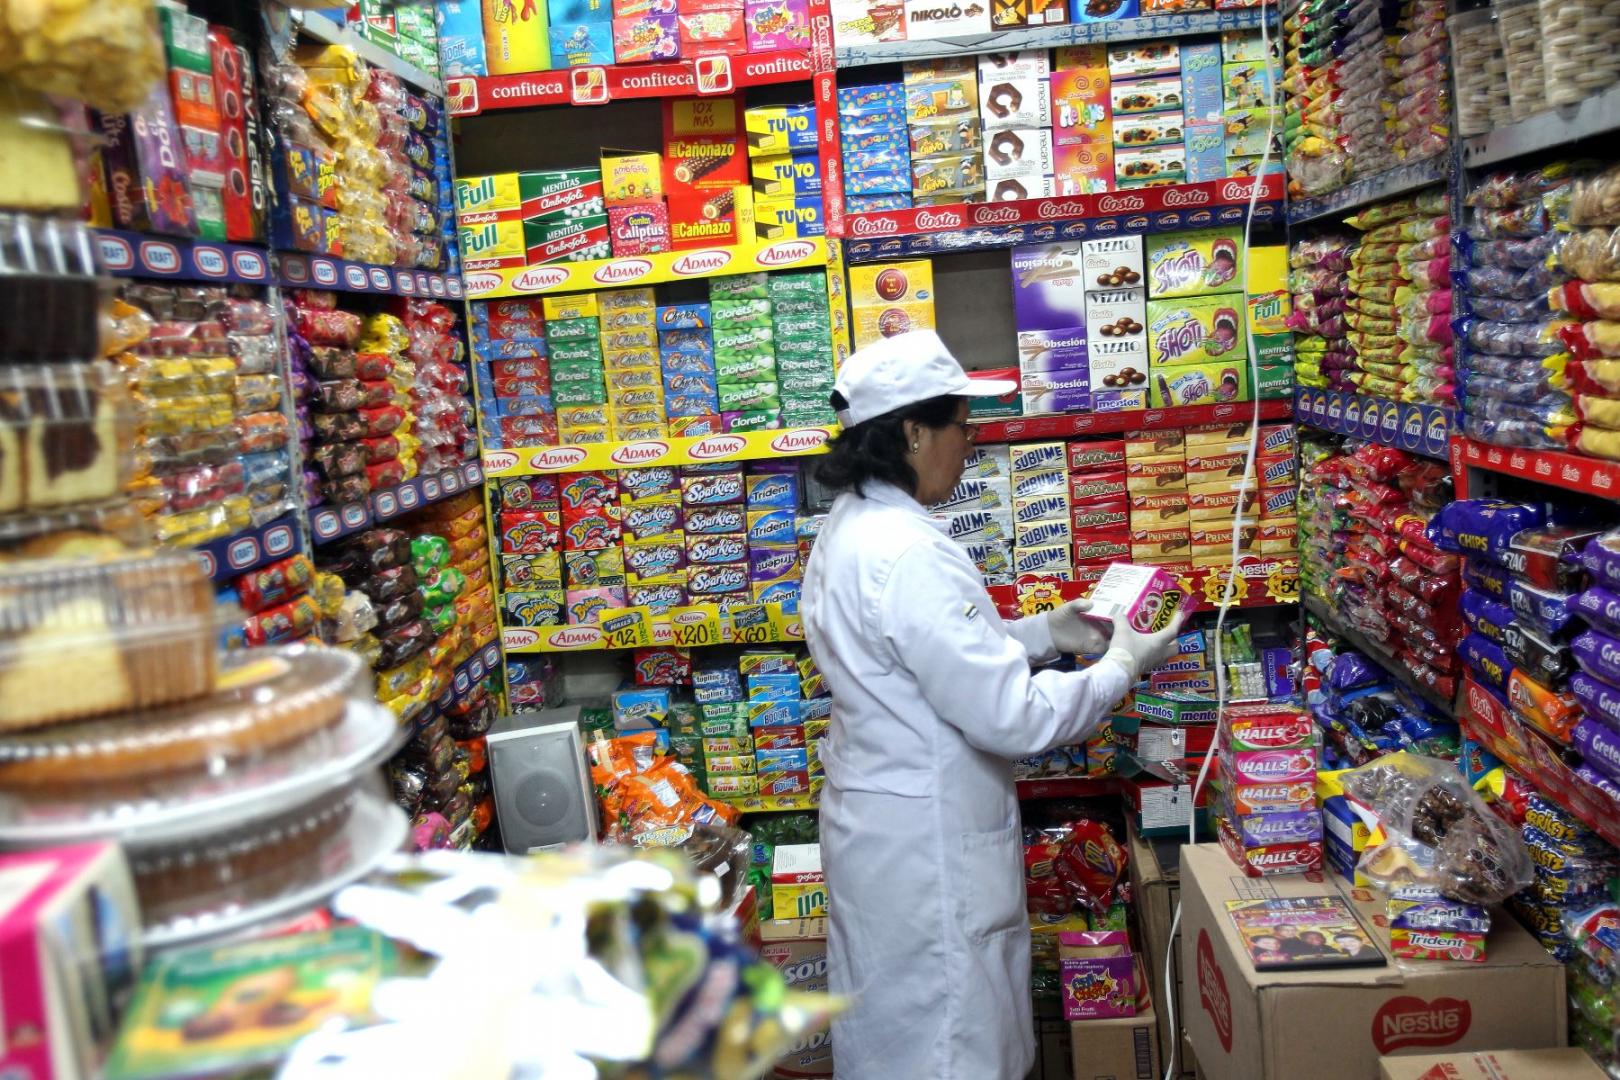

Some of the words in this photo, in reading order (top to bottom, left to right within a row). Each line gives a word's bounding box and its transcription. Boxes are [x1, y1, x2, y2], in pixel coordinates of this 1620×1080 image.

[746, 58, 811, 76] confitec
[622, 71, 694, 89] confiteca
[492, 82, 564, 99] confiteca
[237, 45, 264, 210] PRIVILEGIO
[693, 115, 714, 127] MAS
[767, 116, 809, 132] TUYO
[676, 141, 736, 158] Cañonazo
[774, 163, 815, 179] TUYO
[458, 176, 495, 209] Full
[542, 177, 580, 195] MENTITAS
[1222, 182, 1269, 200] Costa
[540, 189, 584, 209] Ambrosoli
[1098, 195, 1144, 213] Costa
[1162, 189, 1209, 206] Costa
[776, 208, 817, 224] TUYO
[974, 206, 1021, 223] Costa
[1038, 201, 1084, 218] Costa
[852, 217, 898, 235] Costa
[915, 211, 961, 229] Costa
[547, 223, 584, 241] MENTITAS
[617, 225, 664, 242] Caliptus
[679, 222, 731, 238] Cañonazo
[461, 224, 497, 256] Full
[546, 236, 588, 256] Ambrosoli
[102, 246, 125, 260] RAFT
[148, 251, 172, 263] KRAFT
[764, 245, 808, 262] ADAMS
[602, 262, 645, 280] ADAMS
[680, 254, 724, 271] ADAMS
[465, 279, 497, 292] DAMS
[519, 270, 562, 287] ADAMS
[772, 280, 812, 292] Clorets
[715, 305, 751, 319] Clorets
[1254, 301, 1281, 321] Full
[550, 325, 586, 337] Clorets
[717, 332, 753, 348] Clorets
[1043, 337, 1087, 348] Obsesión
[719, 361, 755, 377] Clorets
[1046, 378, 1089, 389] Obsesión
[722, 388, 759, 403] Clorets
[730, 414, 767, 428] Clorets
[1363, 413, 1378, 425] ARCOR
[1382, 418, 1397, 431] ARCOR
[1140, 430, 1182, 440] PRINCESA
[1403, 421, 1422, 436] ARCOR
[1427, 425, 1446, 441] ARCOR
[779, 433, 822, 448] ADAMS
[1263, 427, 1297, 449] SUBLI
[620, 446, 661, 460] ADAMS
[696, 440, 739, 454] ADAMS
[538, 452, 580, 466] ADAMS
[1014, 446, 1063, 470] SUBLIME
[1200, 456, 1245, 469] PRINCESA
[627, 469, 672, 488] Sparkies
[1142, 465, 1184, 475] PRINCESA
[688, 478, 739, 502] Sparkies
[1016, 471, 1065, 495] SUBLIME
[752, 484, 791, 502] Trident
[1017, 497, 1066, 521] SUBLIME
[1146, 497, 1188, 508] PRINCESA
[629, 507, 675, 527] Sparkies
[690, 507, 741, 532] Sparkies
[753, 521, 791, 538] Trident
[1019, 523, 1069, 547] SUBLIME
[1147, 531, 1188, 542] PRINCESA
[1276, 527, 1298, 537] PRIN
[692, 539, 742, 562] Sparkies
[1457, 533, 1489, 551] CHIPS
[633, 548, 678, 567] Sparkies
[756, 554, 795, 571] Trident
[1018, 547, 1067, 571] SUBLIME
[694, 567, 744, 591] Sparkies
[636, 586, 679, 606] Sparkies
[504, 635, 533, 645] DAMS
[556, 631, 598, 645] ADAMS
[616, 629, 638, 646] 12
[683, 624, 708, 645] 20
[744, 626, 767, 642] 60
[1157, 678, 1210, 690] mentos
[1137, 703, 1174, 719] mentos
[1180, 710, 1218, 722] mento
[1239, 727, 1286, 740] HALLS
[1592, 734, 1620, 765] Grete
[1242, 759, 1289, 773] HALLS
[1241, 788, 1289, 799] HALLS
[1251, 819, 1295, 834] HALLS
[1252, 851, 1297, 866] HALLS
[1409, 932, 1465, 947] Trident
[783, 960, 828, 985] SOD
[1382, 1008, 1460, 1036] Nestlé
